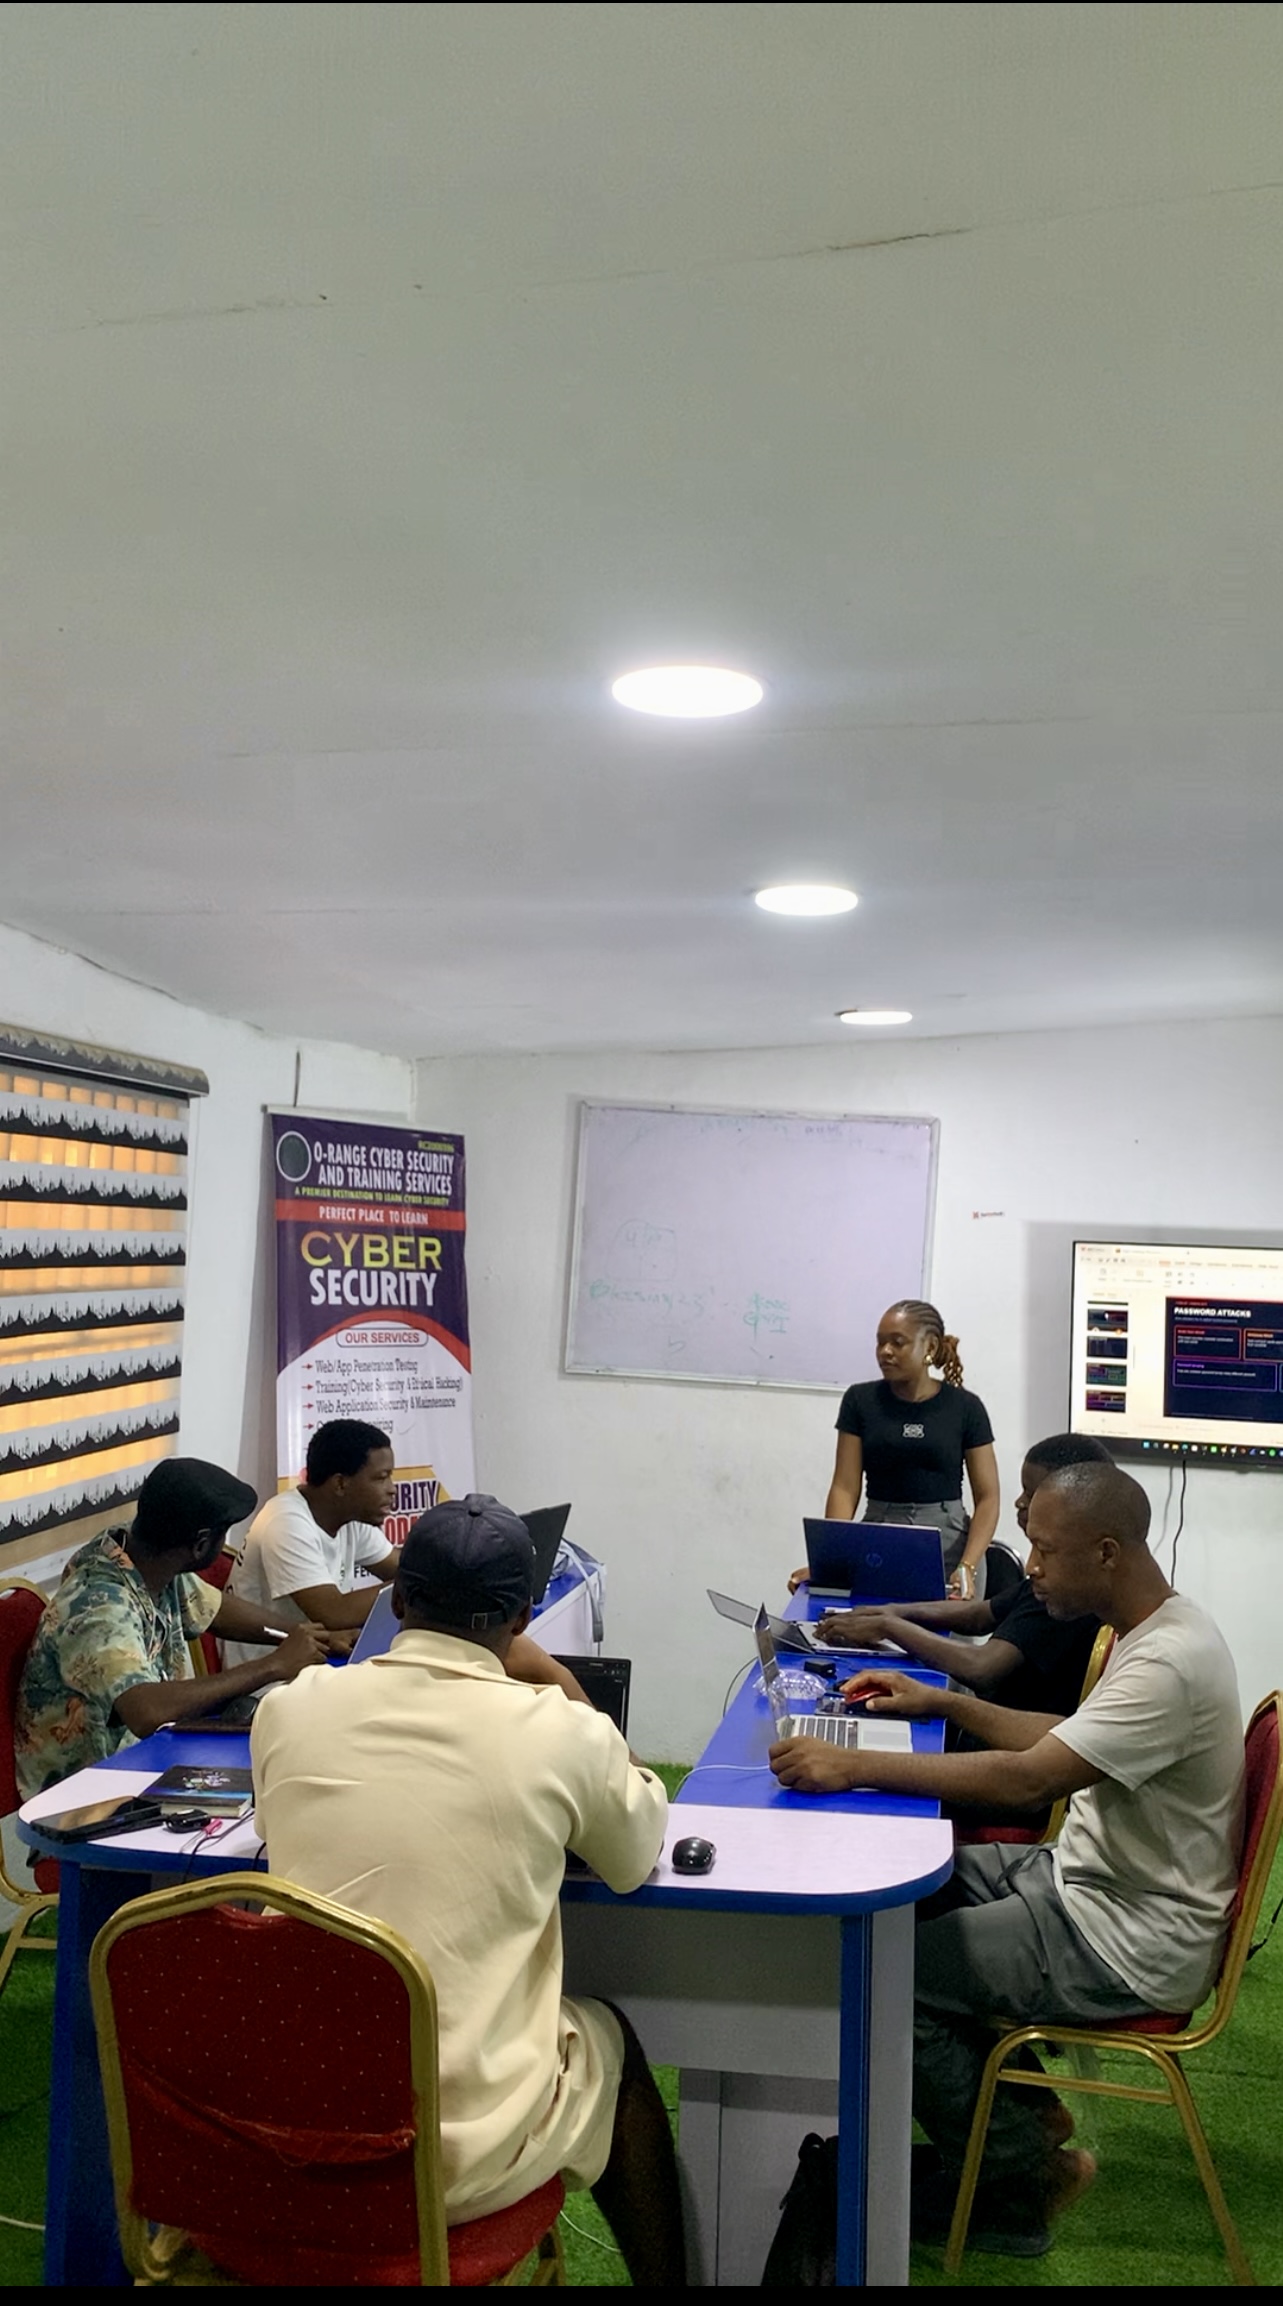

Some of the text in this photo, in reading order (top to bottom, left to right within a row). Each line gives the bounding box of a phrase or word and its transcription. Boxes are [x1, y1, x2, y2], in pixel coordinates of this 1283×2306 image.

[314, 1141, 455, 1174] O-RANGE CYBER SECURITY
[318, 1165, 453, 1196] AND TRAINING SERVICES
[319, 1206, 429, 1225] PERFECT PLACE TO LEARN
[301, 1231, 442, 1270] CYBER
[309, 1268, 437, 1307] SECURITY
[1174, 1307, 1251, 1318] PASSWORD ATTACKS
[345, 1331, 420, 1344] OUR SERVICES
[316, 1400, 334, 1414] Web
[335, 1398, 379, 1416] Application
